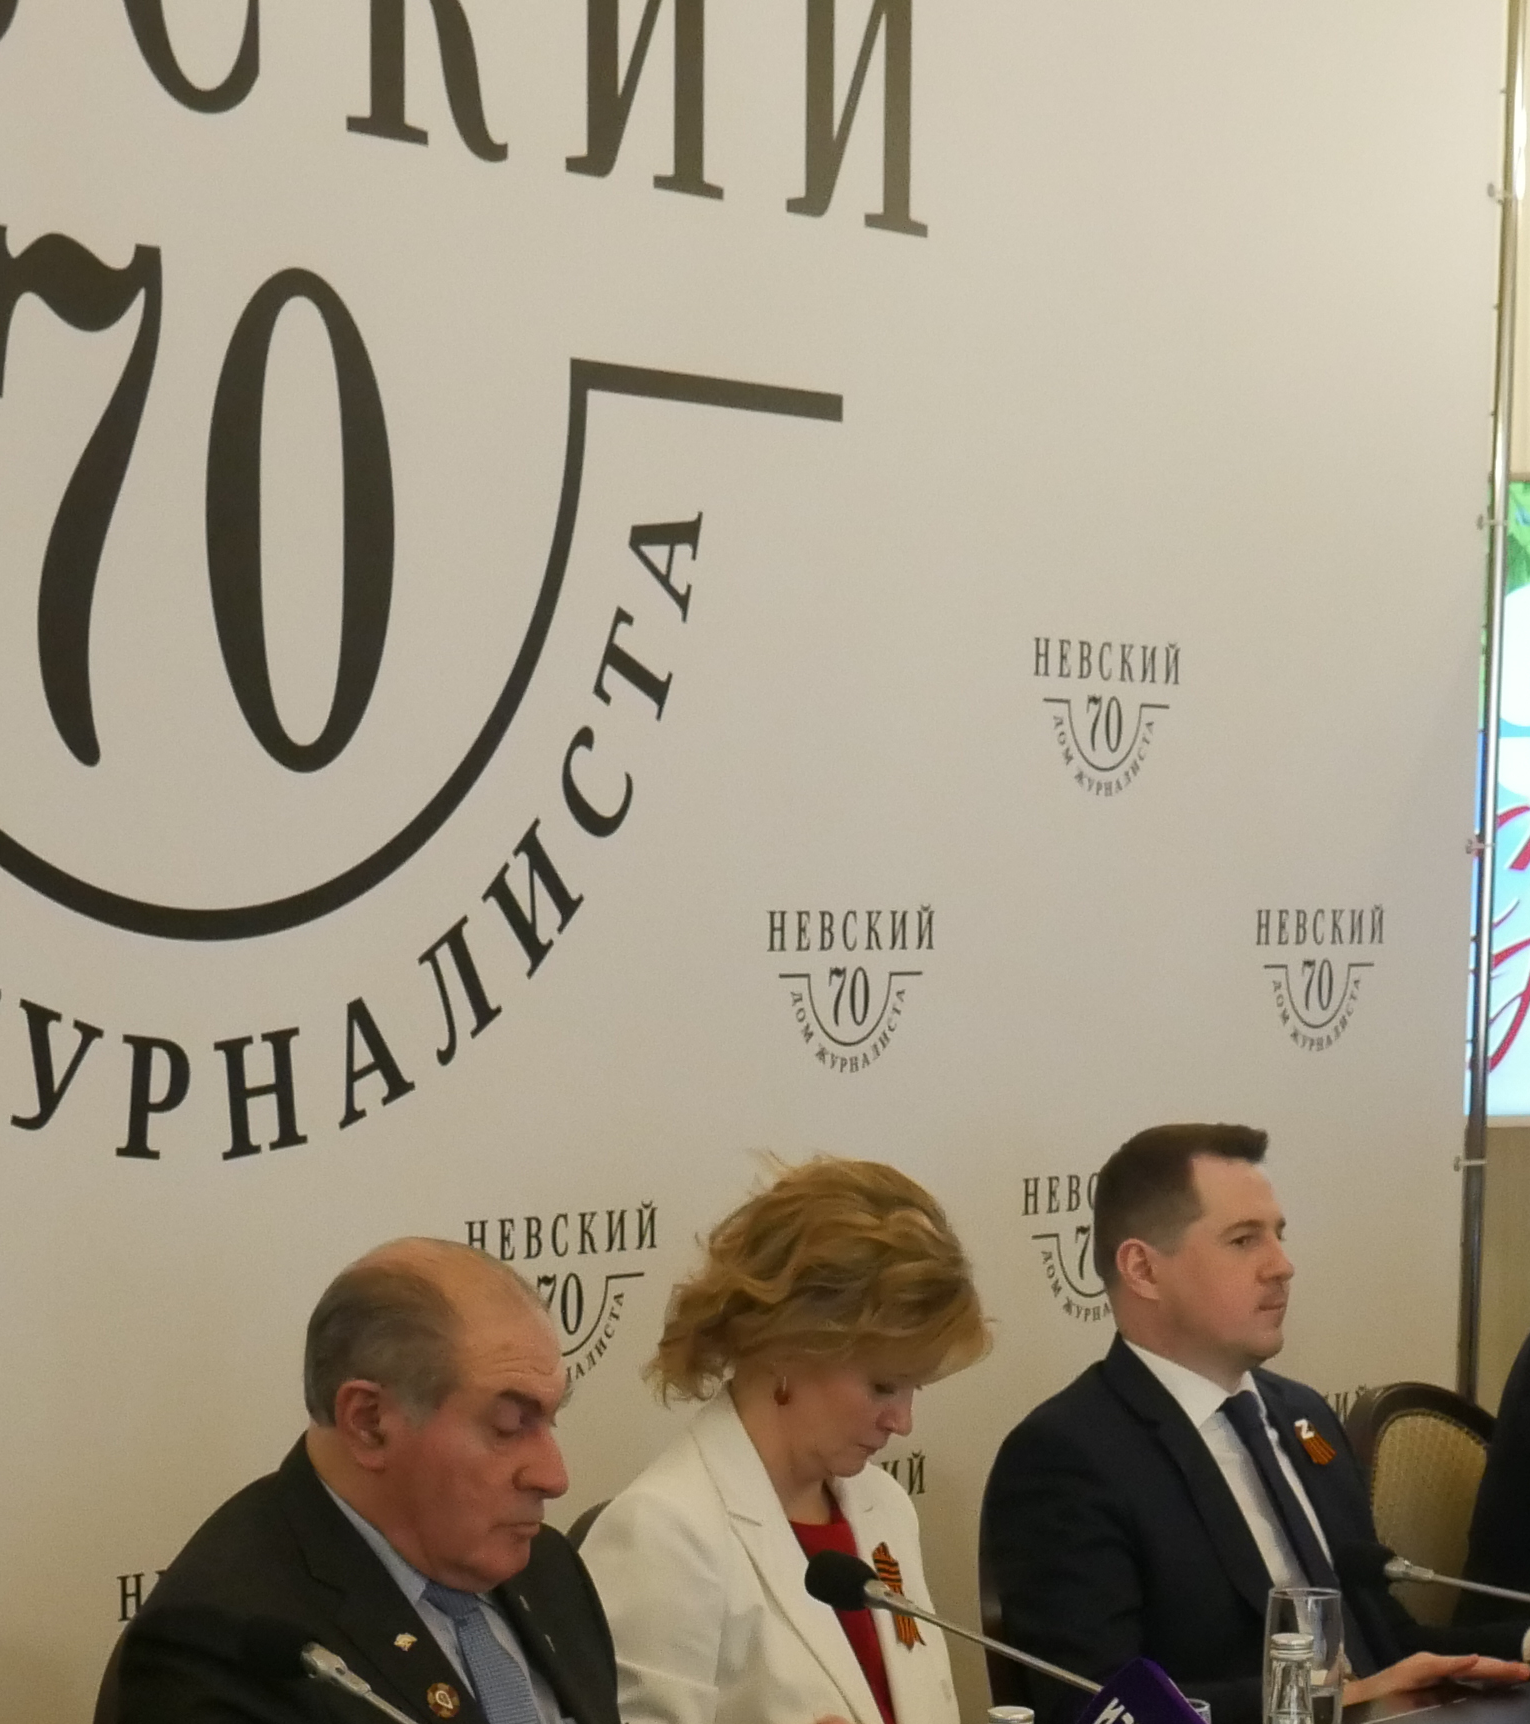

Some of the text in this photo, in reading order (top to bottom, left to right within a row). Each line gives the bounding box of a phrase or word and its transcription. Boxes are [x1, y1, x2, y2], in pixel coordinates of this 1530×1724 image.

[1034, 637, 1181, 685] НЕВСКИЙ
[1086, 694, 1123, 754] 70
[766, 904, 935, 952] НЕВСКИЙ
[1256, 903, 1385, 945] НЕВСКИЙ
[828, 966, 870, 1027] 70
[1301, 958, 1333, 1012] 70
[1022, 1172, 1099, 1216] НЕВС
[464, 1200, 658, 1261] НЕВСКИЙ
[1075, 1223, 1091, 1280] 7
[566, 1292, 624, 1383] АЛИСТА
